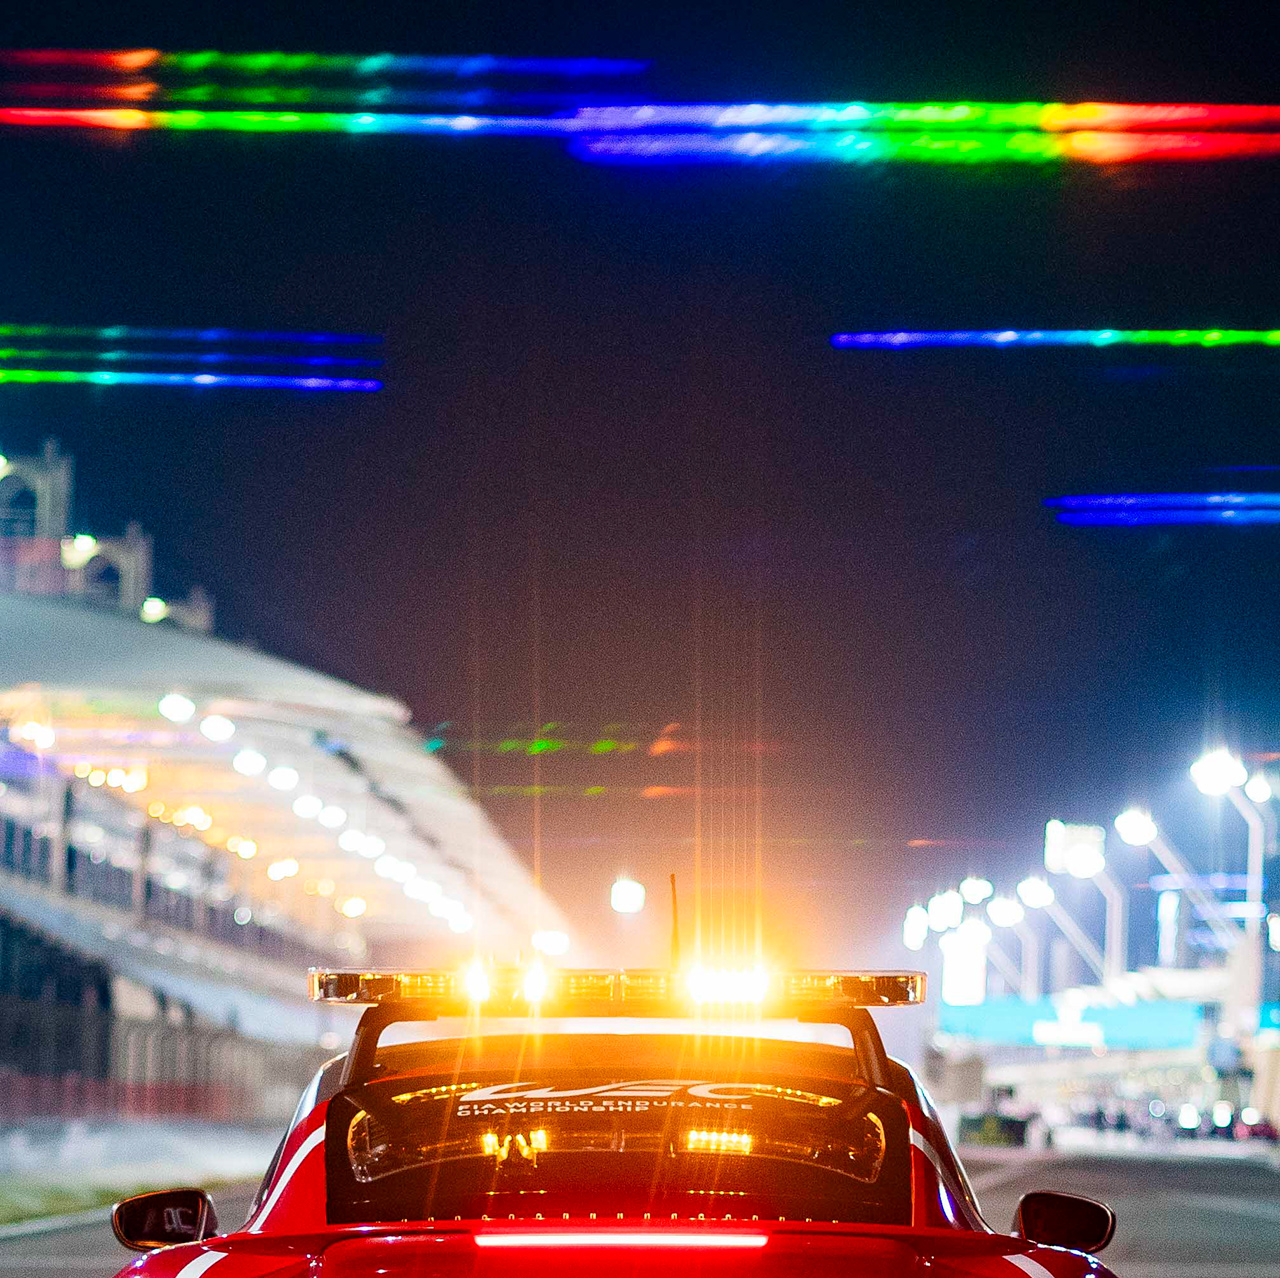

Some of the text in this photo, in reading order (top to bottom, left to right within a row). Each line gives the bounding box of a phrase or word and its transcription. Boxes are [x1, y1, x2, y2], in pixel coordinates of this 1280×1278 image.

[504, 1101, 594, 1109] WORLD
[602, 1101, 754, 1110] ENDURANCE
[456, 1106, 650, 1117] CHAMPIONSHIP
